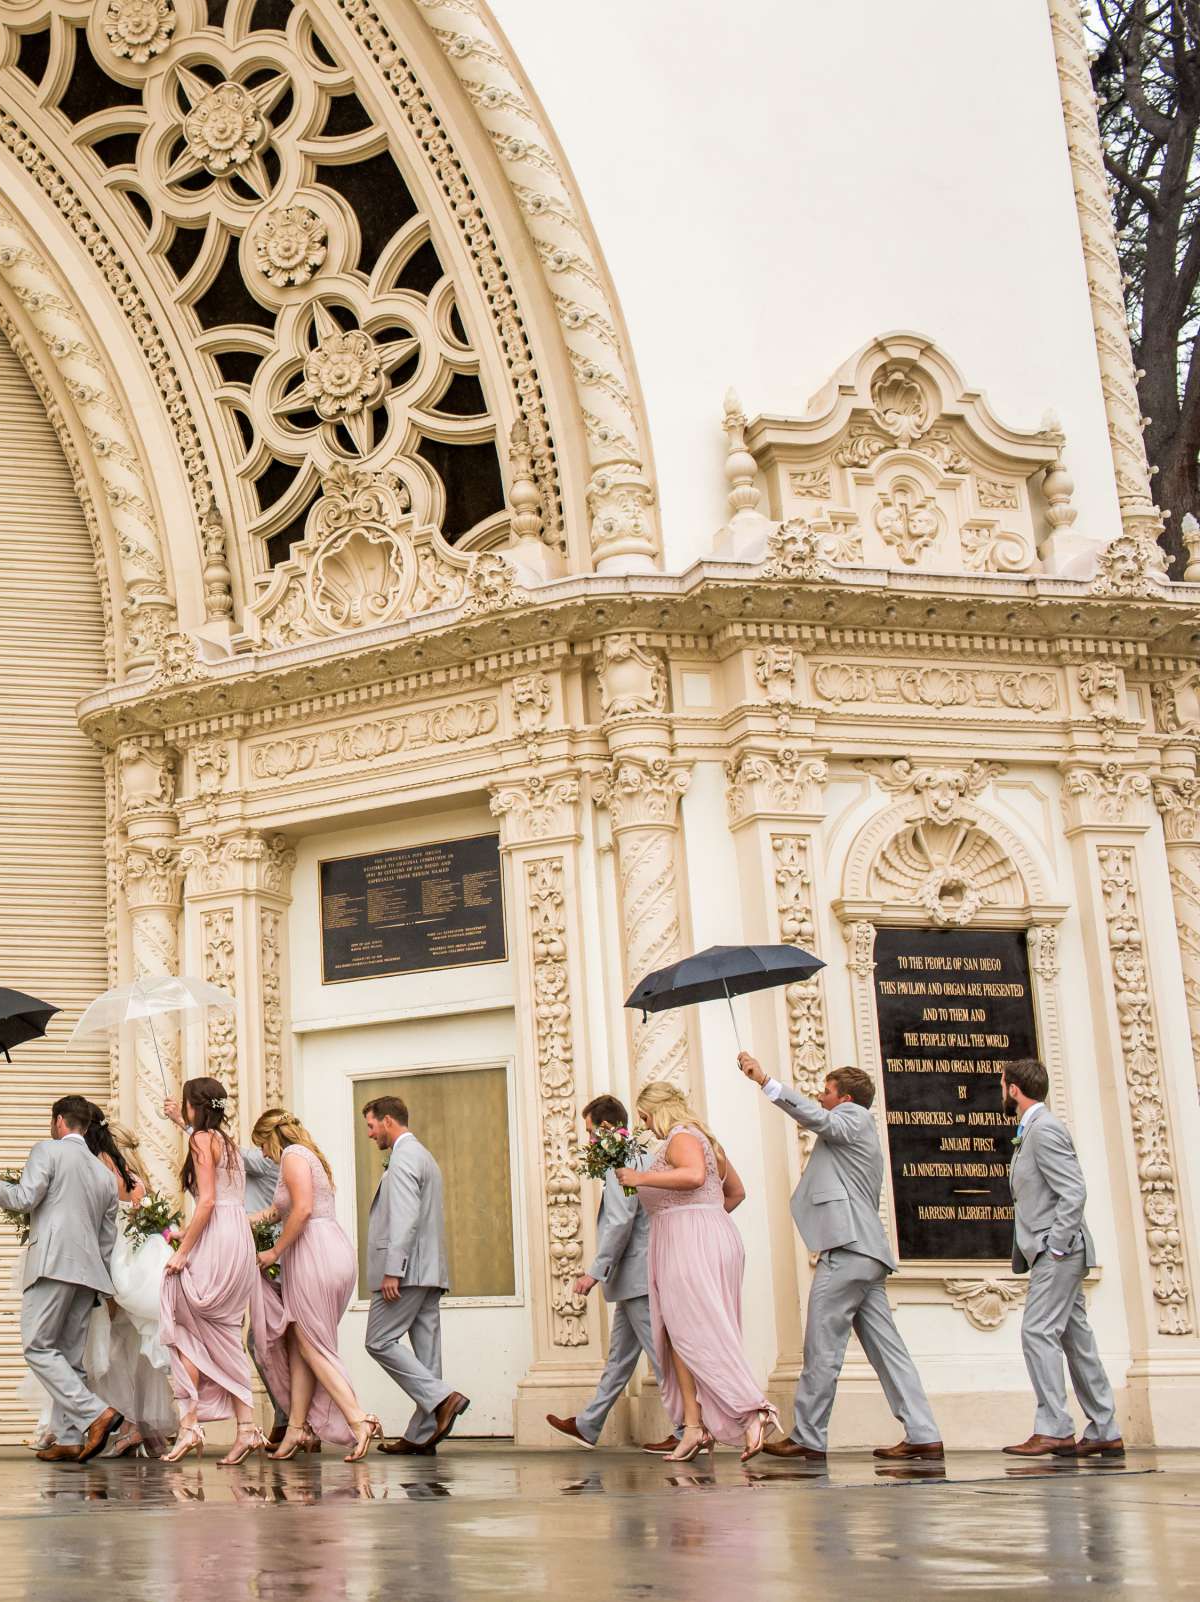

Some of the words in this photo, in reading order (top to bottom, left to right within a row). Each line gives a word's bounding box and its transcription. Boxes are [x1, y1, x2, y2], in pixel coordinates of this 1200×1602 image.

[897, 956, 907, 970] TO
[909, 956, 924, 970] THE
[925, 956, 952, 971] PEOPLE
[953, 957, 963, 970] OF
[963, 957, 979, 971] SAN
[980, 957, 1001, 971] DIEGO
[879, 981, 896, 995] THIS
[897, 981, 926, 995] PAVILION
[927, 982, 942, 996] AND
[943, 982, 966, 996] ORGAN
[967, 983, 982, 996] ARE
[983, 983, 1024, 997] PRESENTED
[922, 1008, 938, 1021] AND
[938, 1008, 948, 1021] TO
[949, 1008, 969, 1021] THEM
[970, 1008, 986, 1021] AND
[903, 1033, 919, 1046] THE
[919, 1033, 946, 1047] PEOPLE
[947, 1033, 956, 1047] OF
[956, 1033, 971, 1047] ALL
[971, 1033, 984, 1047] THE
[985, 1034, 1009, 1047] WORLD
[886, 1059, 903, 1073] THIS
[904, 1059, 933, 1073] PAVILION
[935, 1059, 950, 1073] AND
[950, 1060, 974, 1073] ORGAN
[976, 1060, 992, 1073] ARE
[958, 1086, 967, 1099] BY
[910, 1112, 953, 1125] SPRECKELS
[955, 1114, 966, 1123] AND
[968, 1112, 995, 1125] ADOLPH
[939, 1138, 971, 1152] JANUARY
[917, 1164, 953, 1177] NINETEEN
[954, 1164, 989, 1177] HUNDRED
[989, 1164, 1005, 1177] AND
[918, 1206, 956, 1220] HARRISON
[957, 1206, 992, 1220] ALBRIGHT
